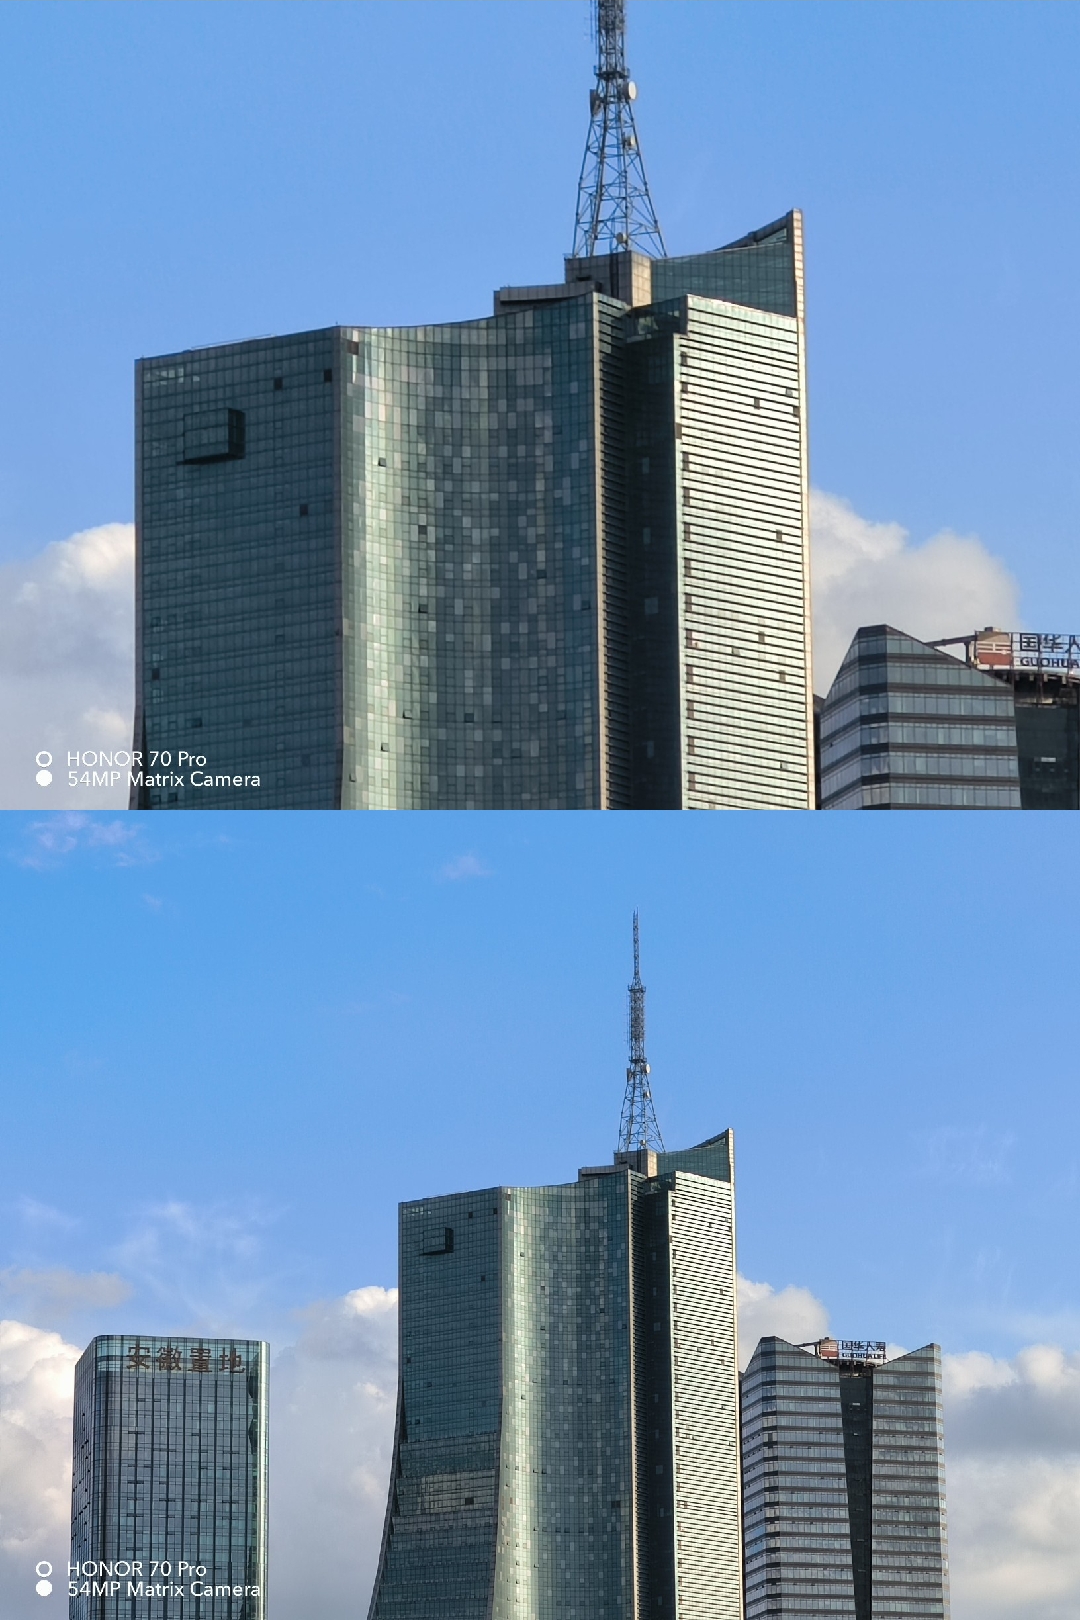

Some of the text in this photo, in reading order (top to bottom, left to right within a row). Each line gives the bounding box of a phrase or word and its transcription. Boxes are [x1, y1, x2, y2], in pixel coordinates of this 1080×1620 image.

[1020, 657, 1080, 668] GUOHUA
[126, 1344, 246, 1374] 安徽置地
